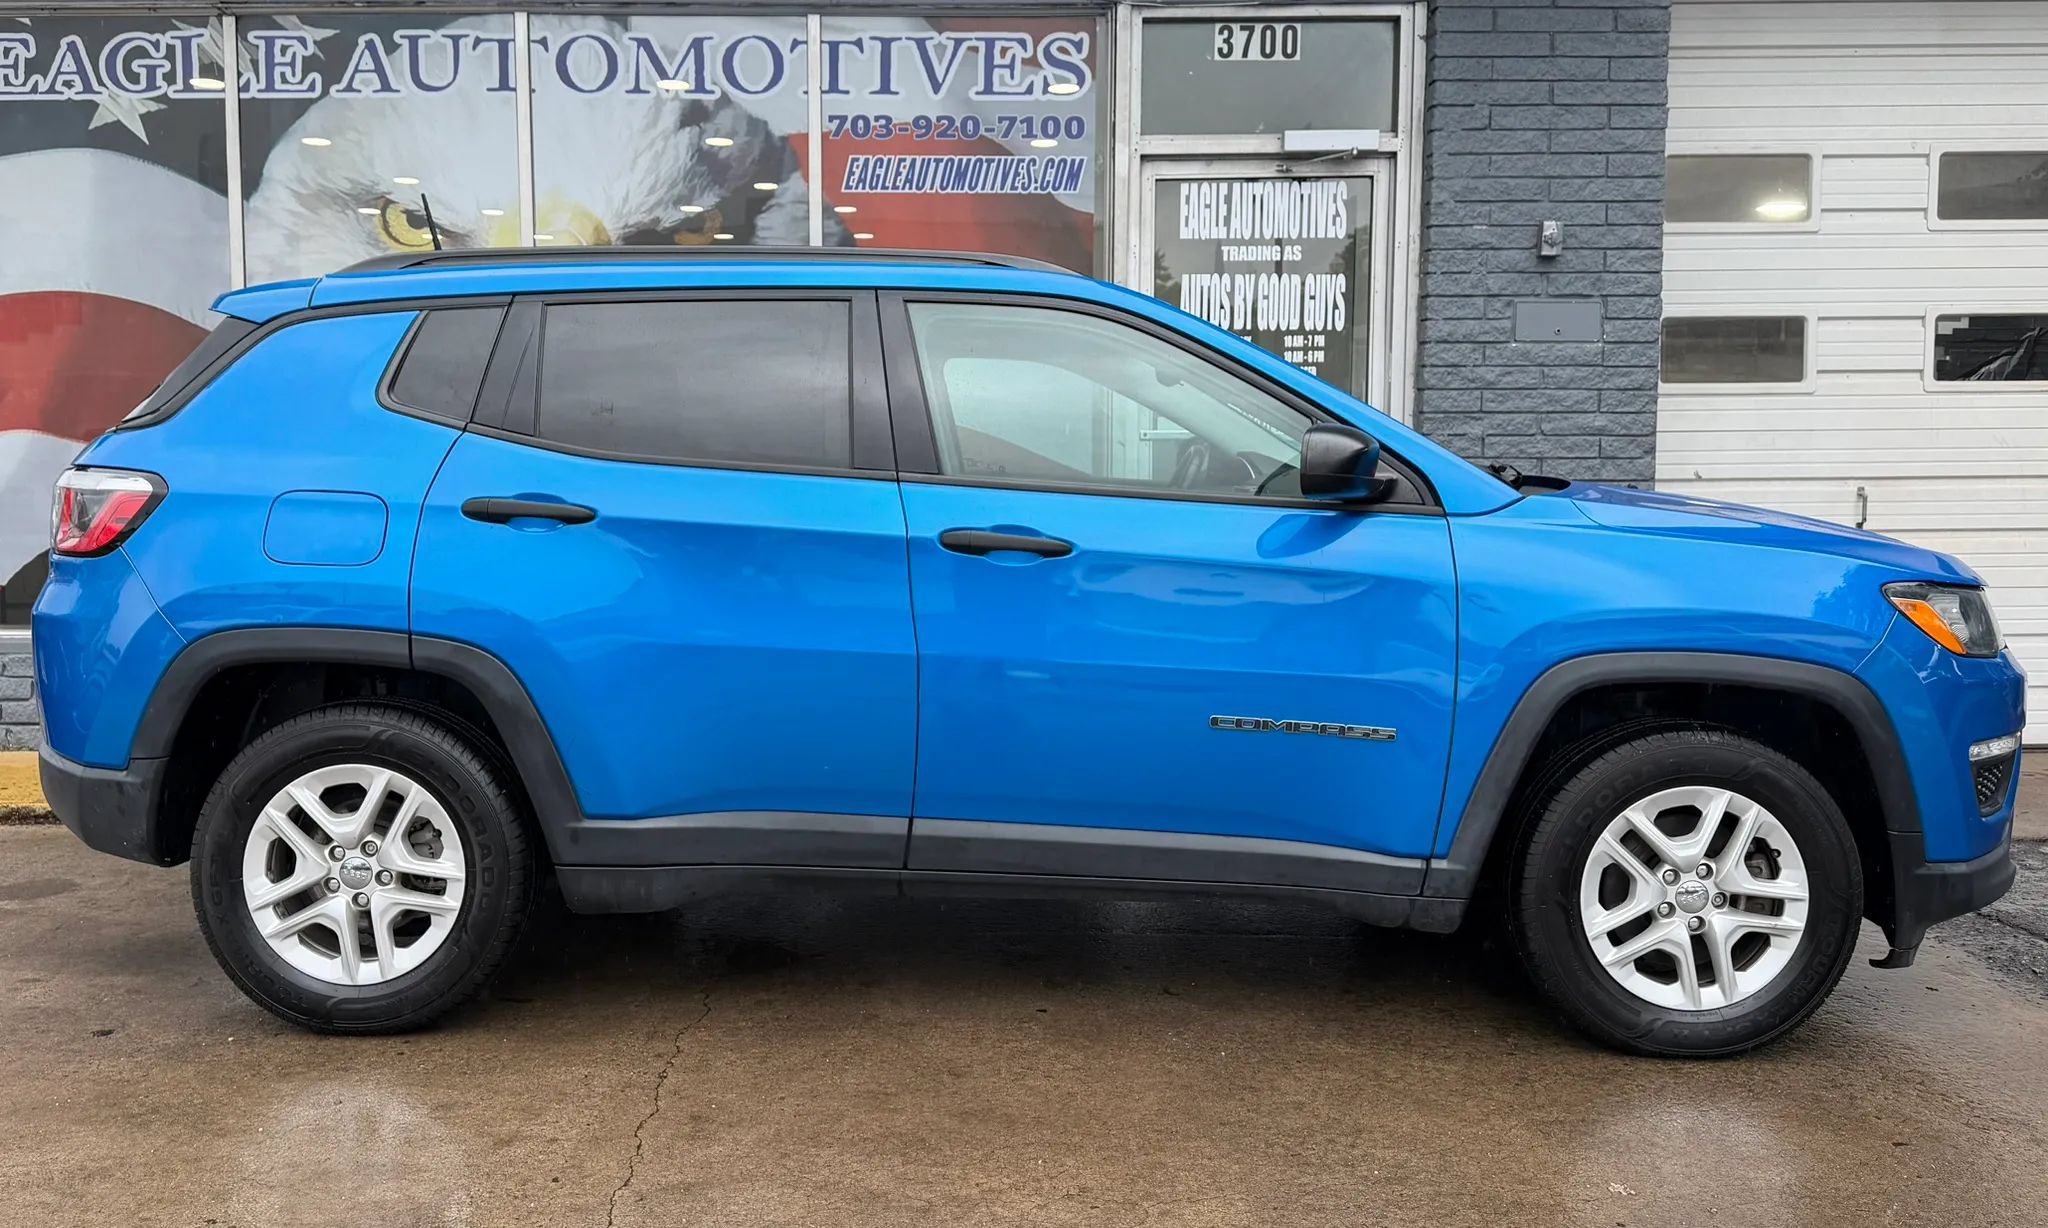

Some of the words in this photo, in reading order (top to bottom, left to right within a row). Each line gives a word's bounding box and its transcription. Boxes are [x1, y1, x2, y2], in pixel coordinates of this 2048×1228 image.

[1217, 24, 1299, 59] 3700
[0, 31, 321, 99] EAGLE
[331, 31, 1095, 99] AUTOMOTIVES
[828, 114, 1086, 140] 703-920-7100
[843, 156, 1086, 193] EAGLEAUTOMOTIVES.COM
[1180, 181, 1229, 240] EAGLE
[1229, 180, 1348, 240] AUTOMOTIVES
[1221, 245, 1282, 261] TRADING
[1283, 245, 1302, 261] AS
[1180, 273, 1231, 330] AUTOS
[1233, 273, 1256, 330] BY
[1257, 273, 1301, 331] GOOD
[1303, 273, 1347, 331] GUYS
[1284, 335, 1293, 348] 10
[1293, 335, 1304, 348] AM
[1314, 335, 1325, 348] PM
[1314, 350, 1325, 363] PM
[1209, 715, 1397, 741] COMPASS
